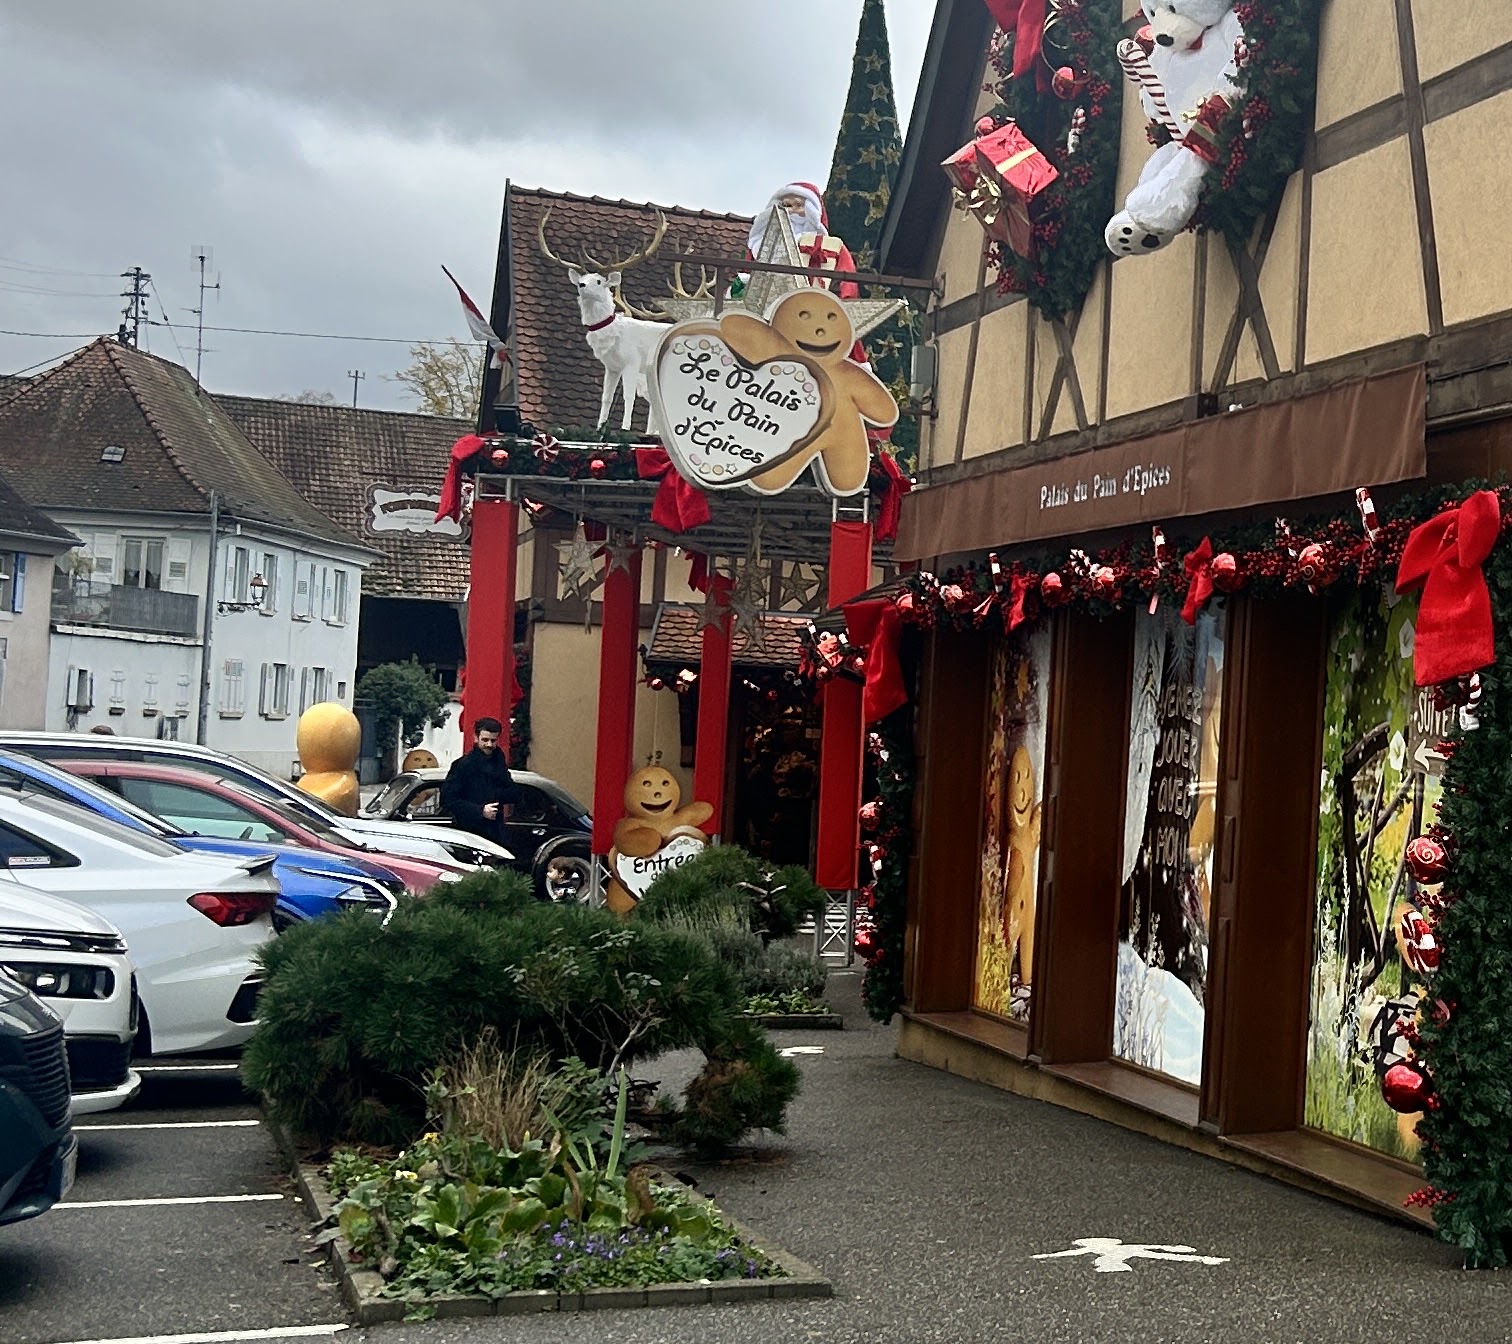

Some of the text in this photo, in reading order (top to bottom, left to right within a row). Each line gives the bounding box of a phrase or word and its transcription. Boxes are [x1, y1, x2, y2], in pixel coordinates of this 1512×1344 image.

[679, 352, 802, 412] Le Palais
[687, 386, 781, 436] du Pain
[674, 416, 765, 464] d'Épices
[1040, 463, 1171, 509] Palais du Pain d'Epices
[1156, 727, 1199, 774] JOUER
